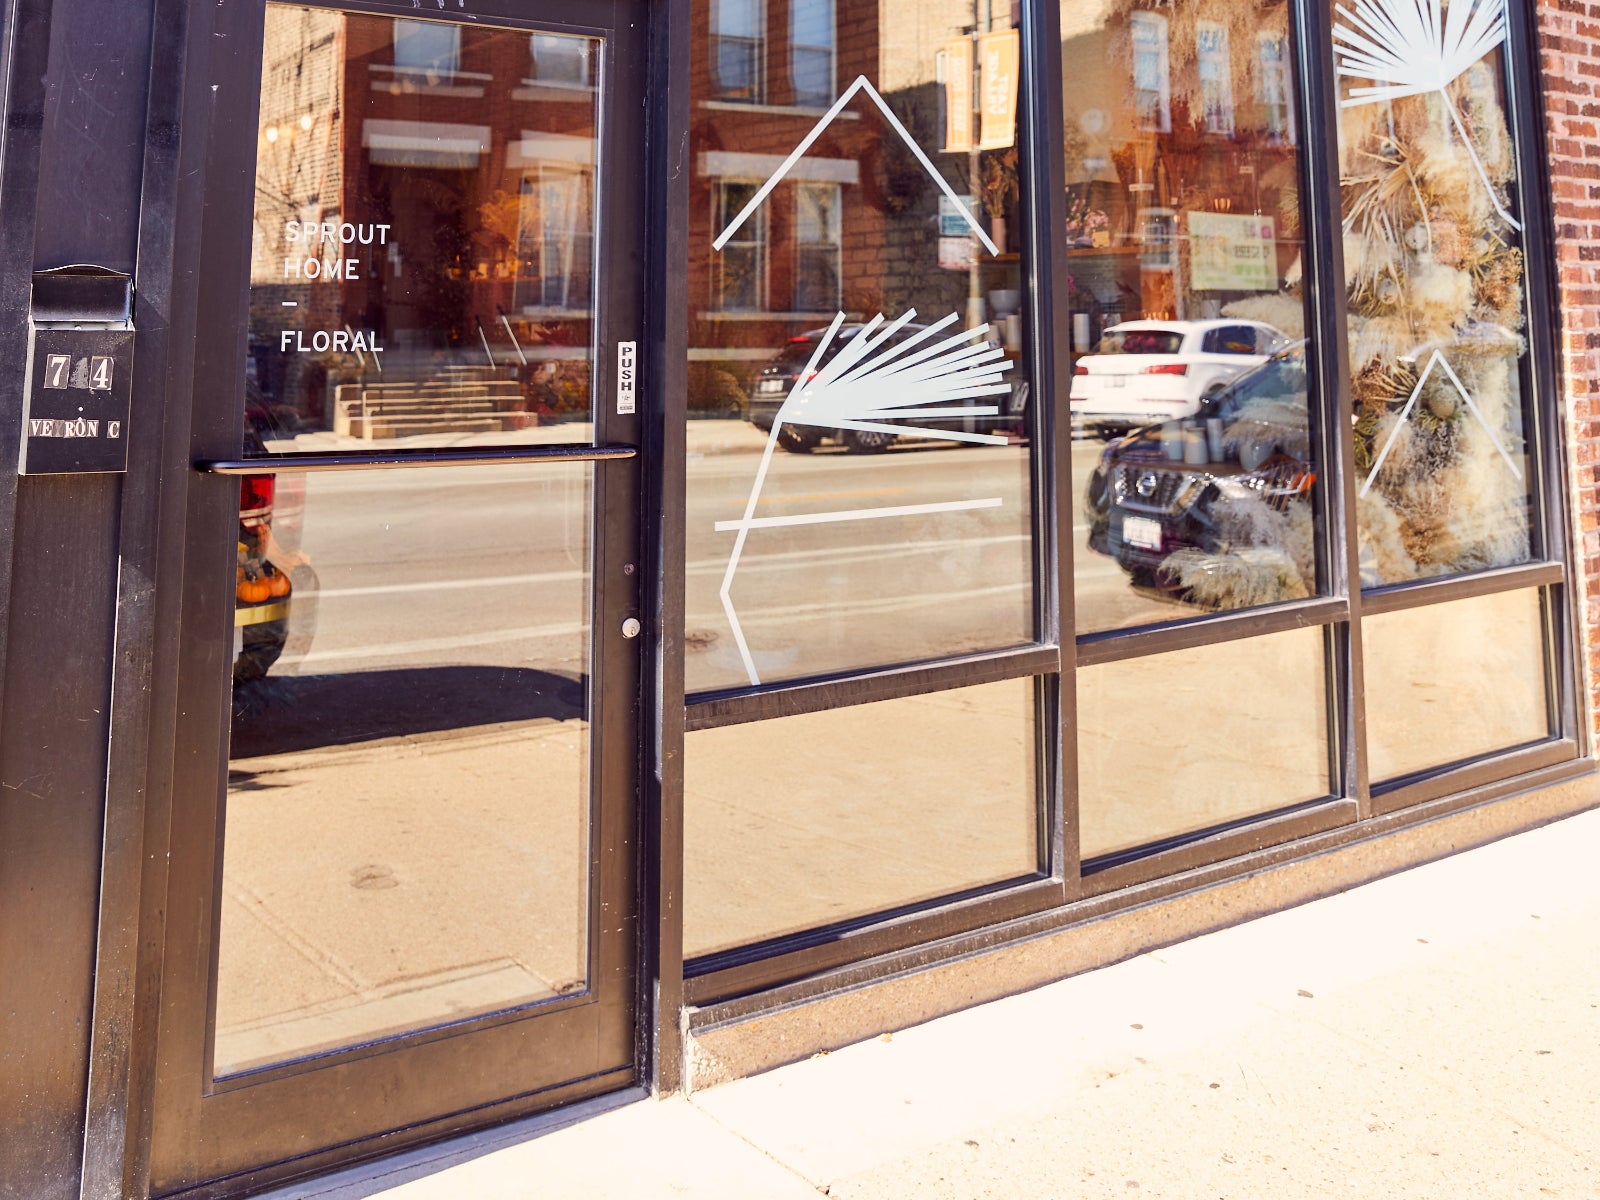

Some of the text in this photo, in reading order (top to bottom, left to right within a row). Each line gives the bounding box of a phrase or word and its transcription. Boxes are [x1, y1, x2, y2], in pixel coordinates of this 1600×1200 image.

[285, 221, 391, 245] SPROUT
[283, 257, 360, 280] HOME
[281, 330, 384, 352] FLORAL
[620, 346, 633, 391] PUSH
[109, 421, 120, 438] C
